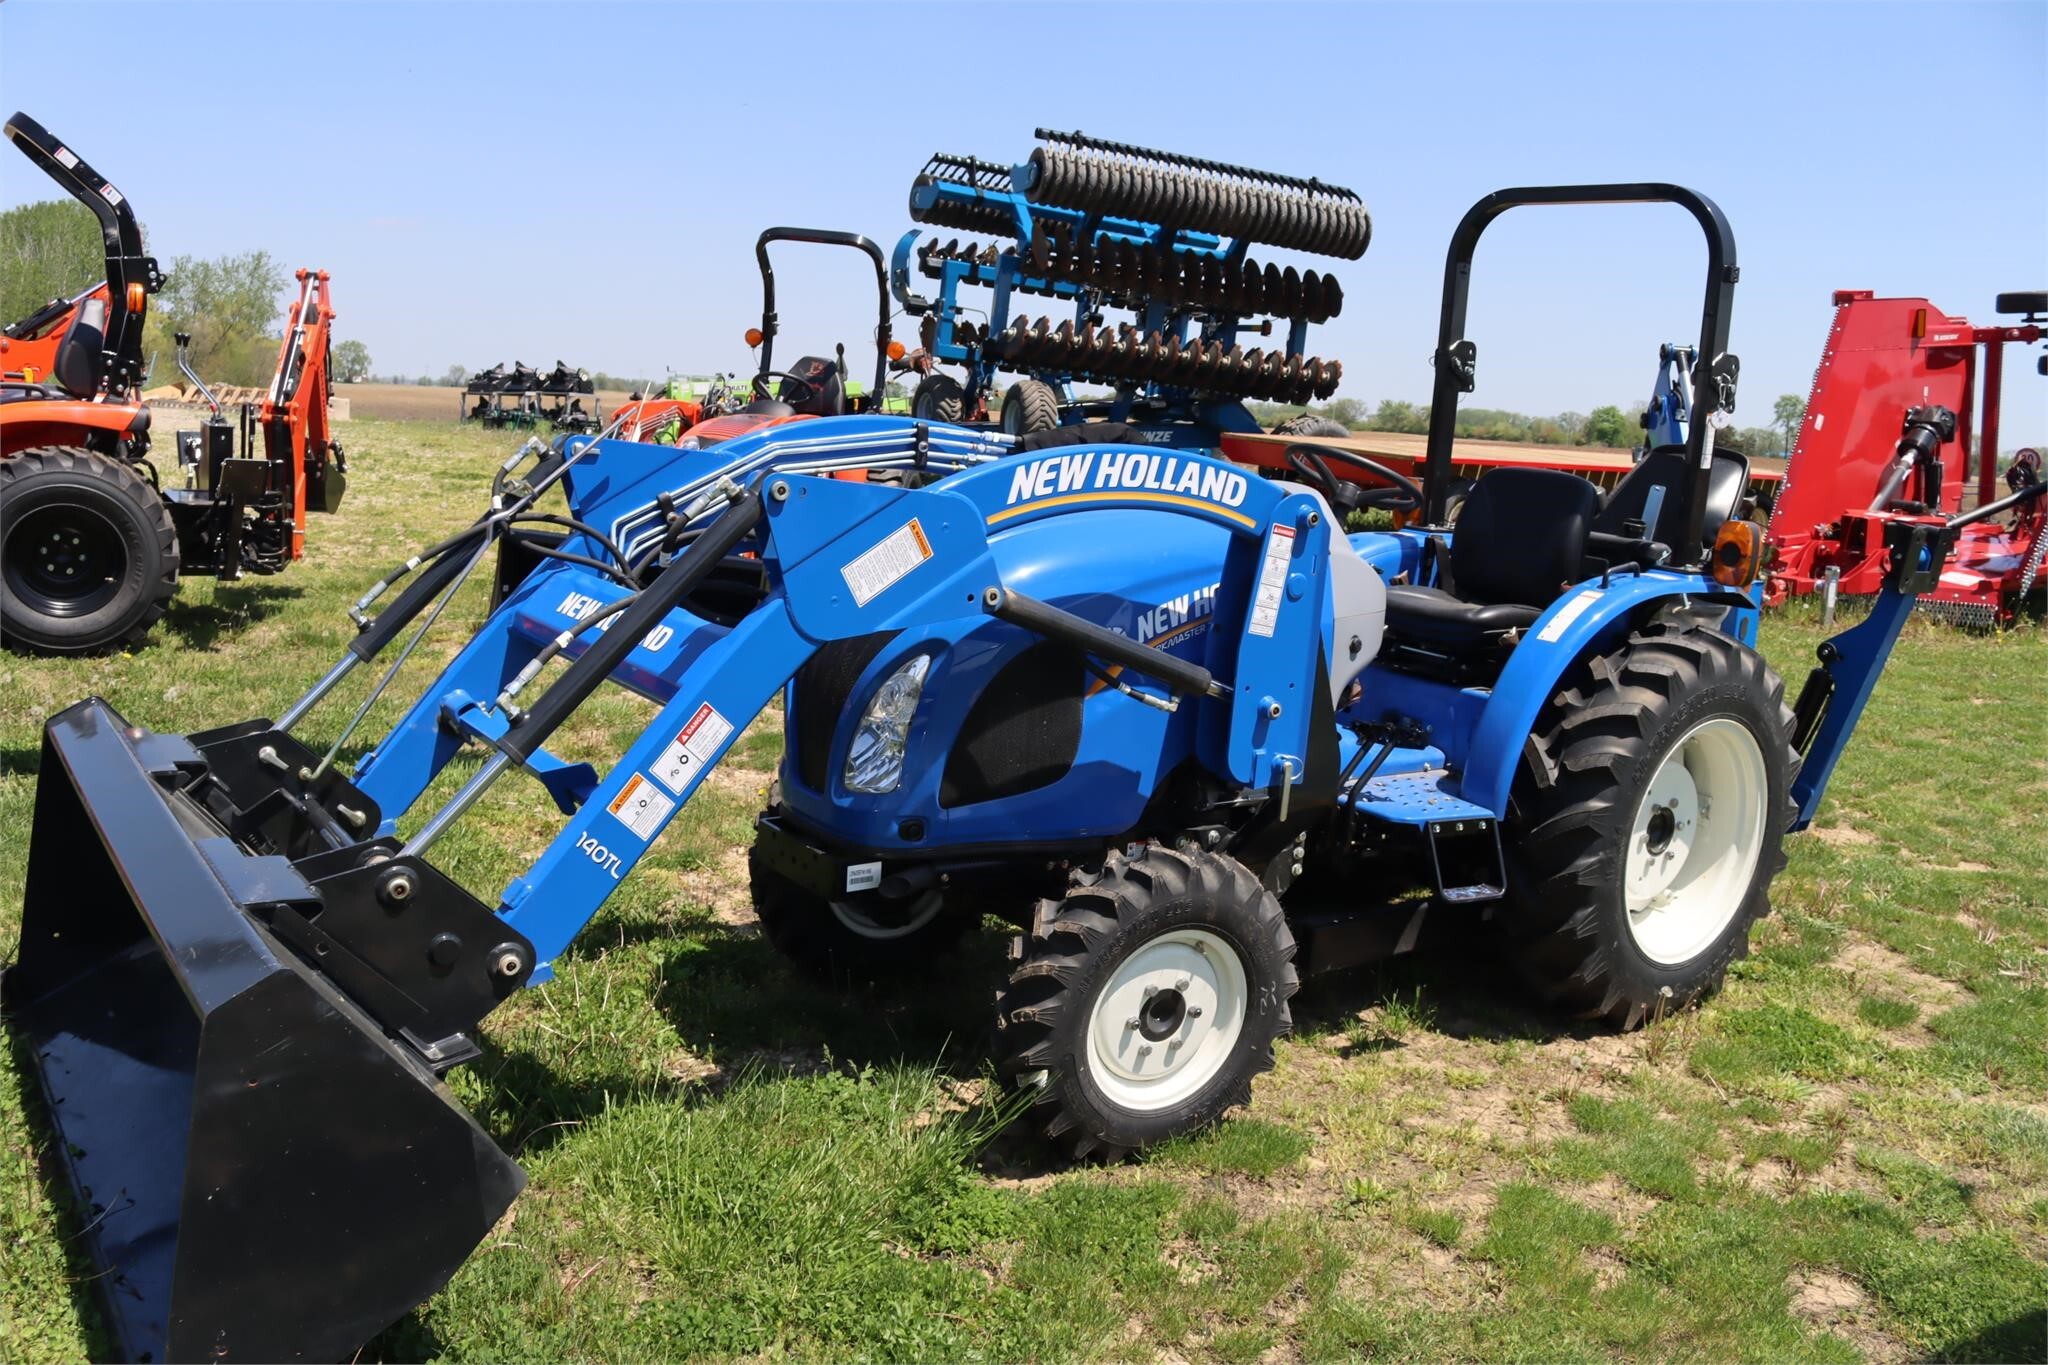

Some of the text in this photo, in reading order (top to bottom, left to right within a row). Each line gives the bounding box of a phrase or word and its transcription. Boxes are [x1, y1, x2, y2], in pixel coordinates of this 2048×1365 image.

[1139, 431, 1174, 442] NZE
[1006, 452, 1248, 507] NEW HOLLAND
[556, 591, 603, 621] NEW
[1137, 593, 1190, 644] NEW
[687, 708, 709, 734] DANGER
[575, 830, 622, 880] 140TL
